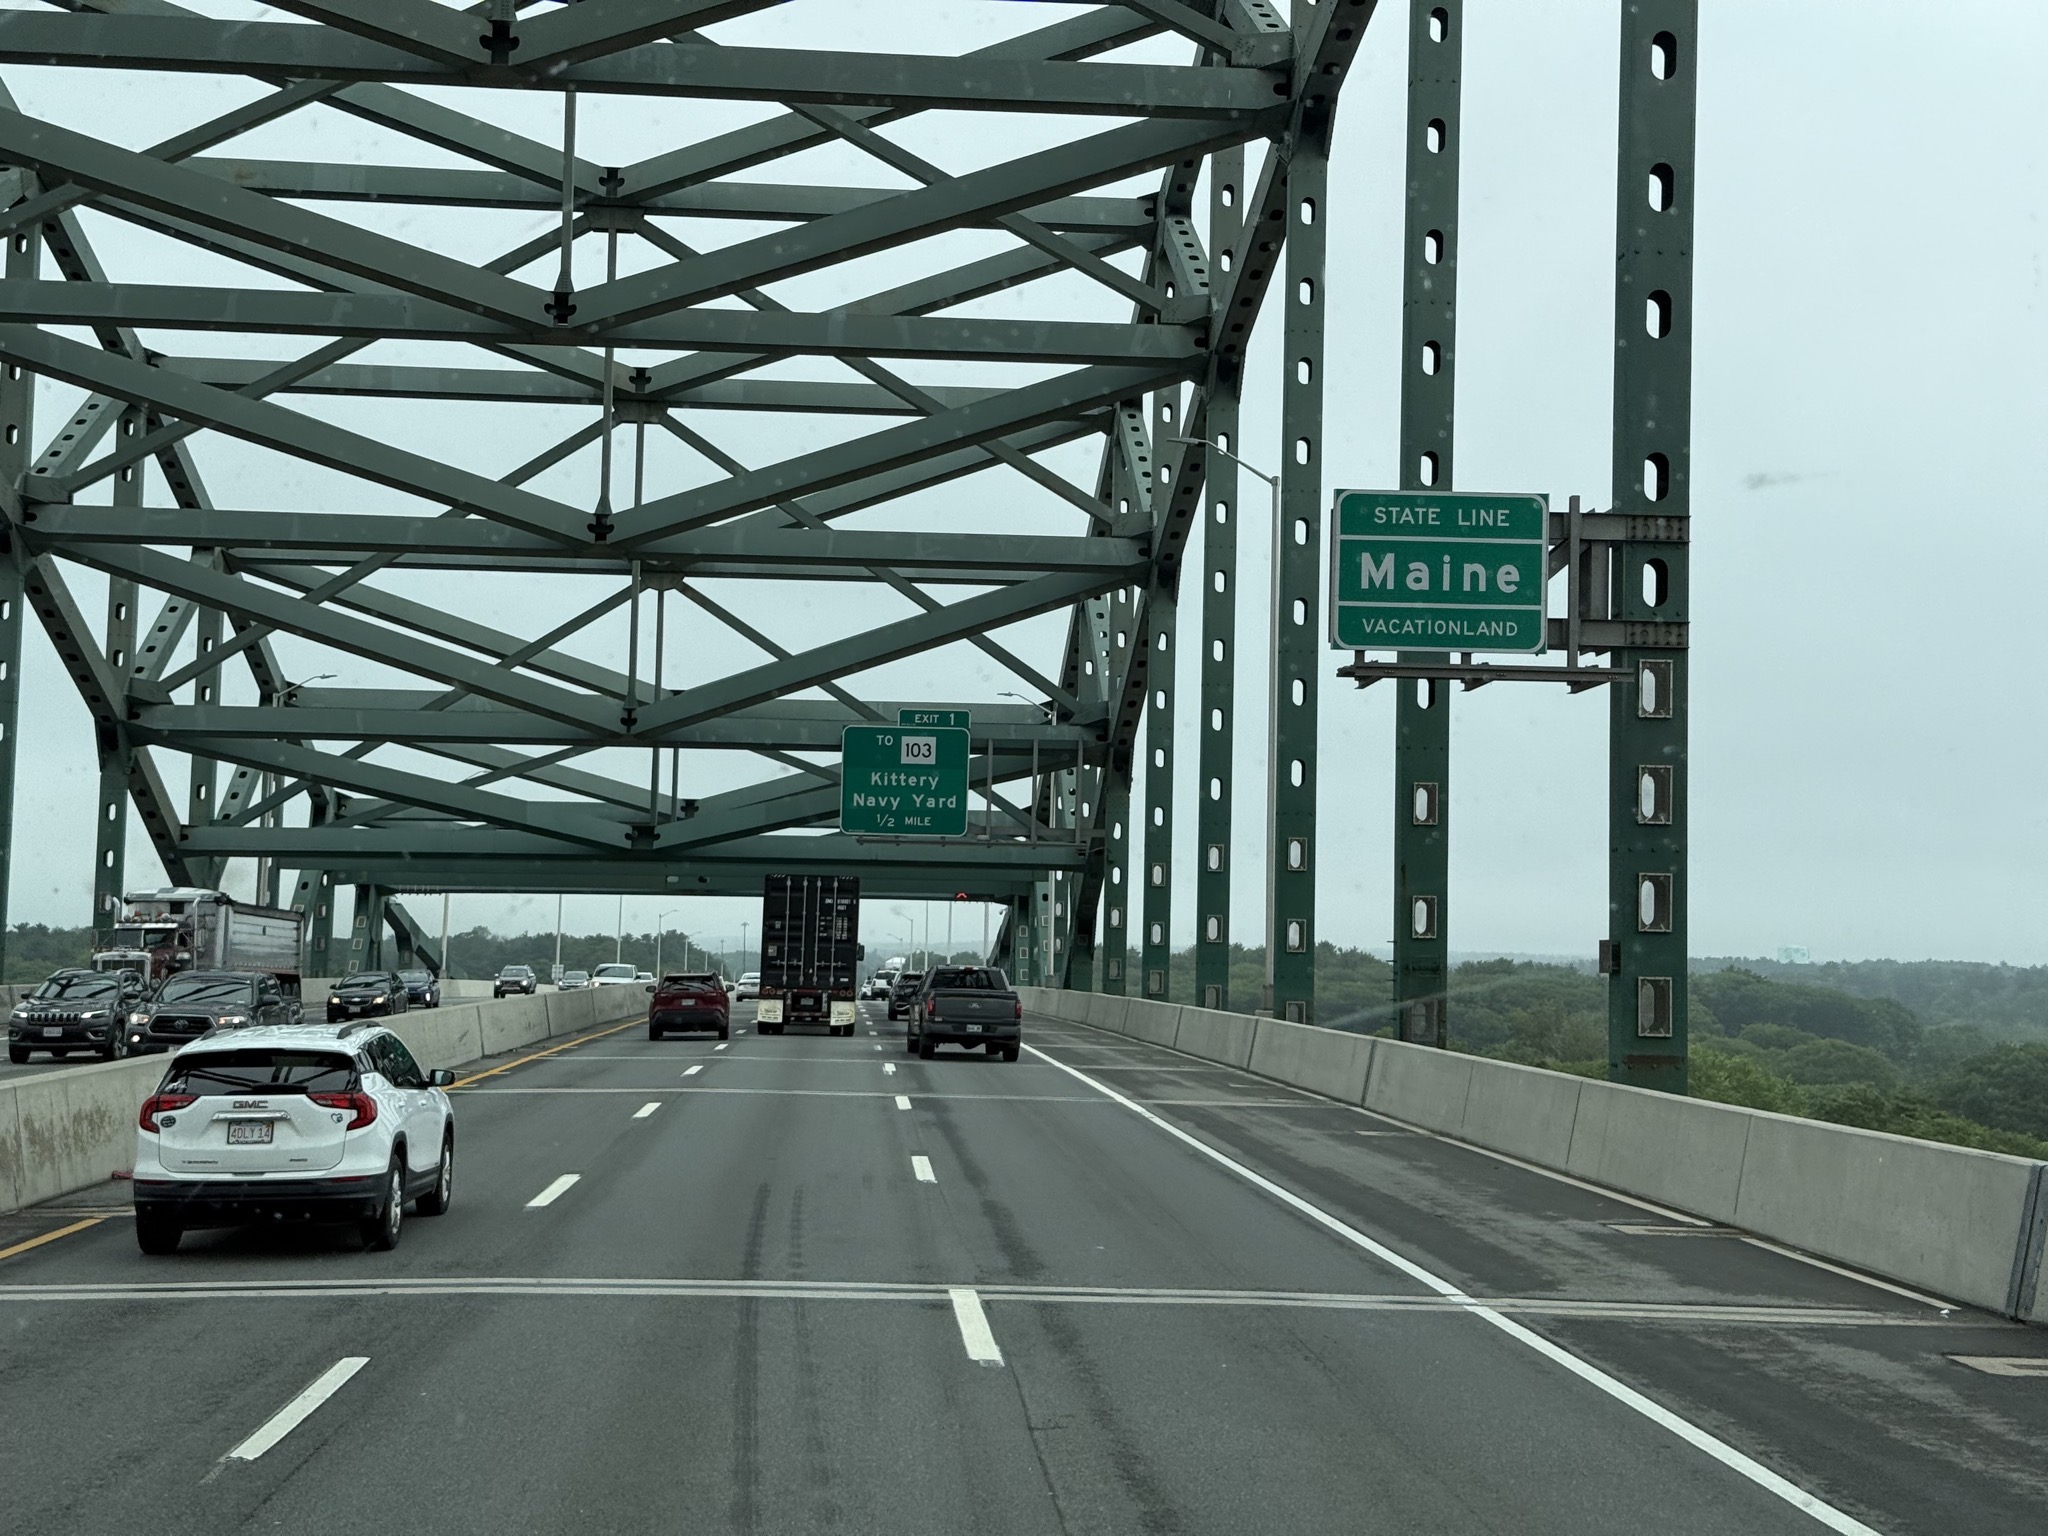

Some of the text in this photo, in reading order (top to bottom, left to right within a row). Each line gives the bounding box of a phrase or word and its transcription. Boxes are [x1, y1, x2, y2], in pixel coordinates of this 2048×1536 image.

[1374, 507, 1510, 527] STATE LINE
[1361, 552, 1520, 593] Maine
[1362, 618, 1518, 636] VACATIONLAND
[914, 713, 954, 726] EXIT 1
[876, 735, 894, 746] TO
[905, 742, 932, 758] 103
[871, 772, 939, 790] Kittery
[853, 793, 957, 811] Navy Yard
[904, 816, 932, 826] MILE
[232, 1100, 269, 1109] GMC
